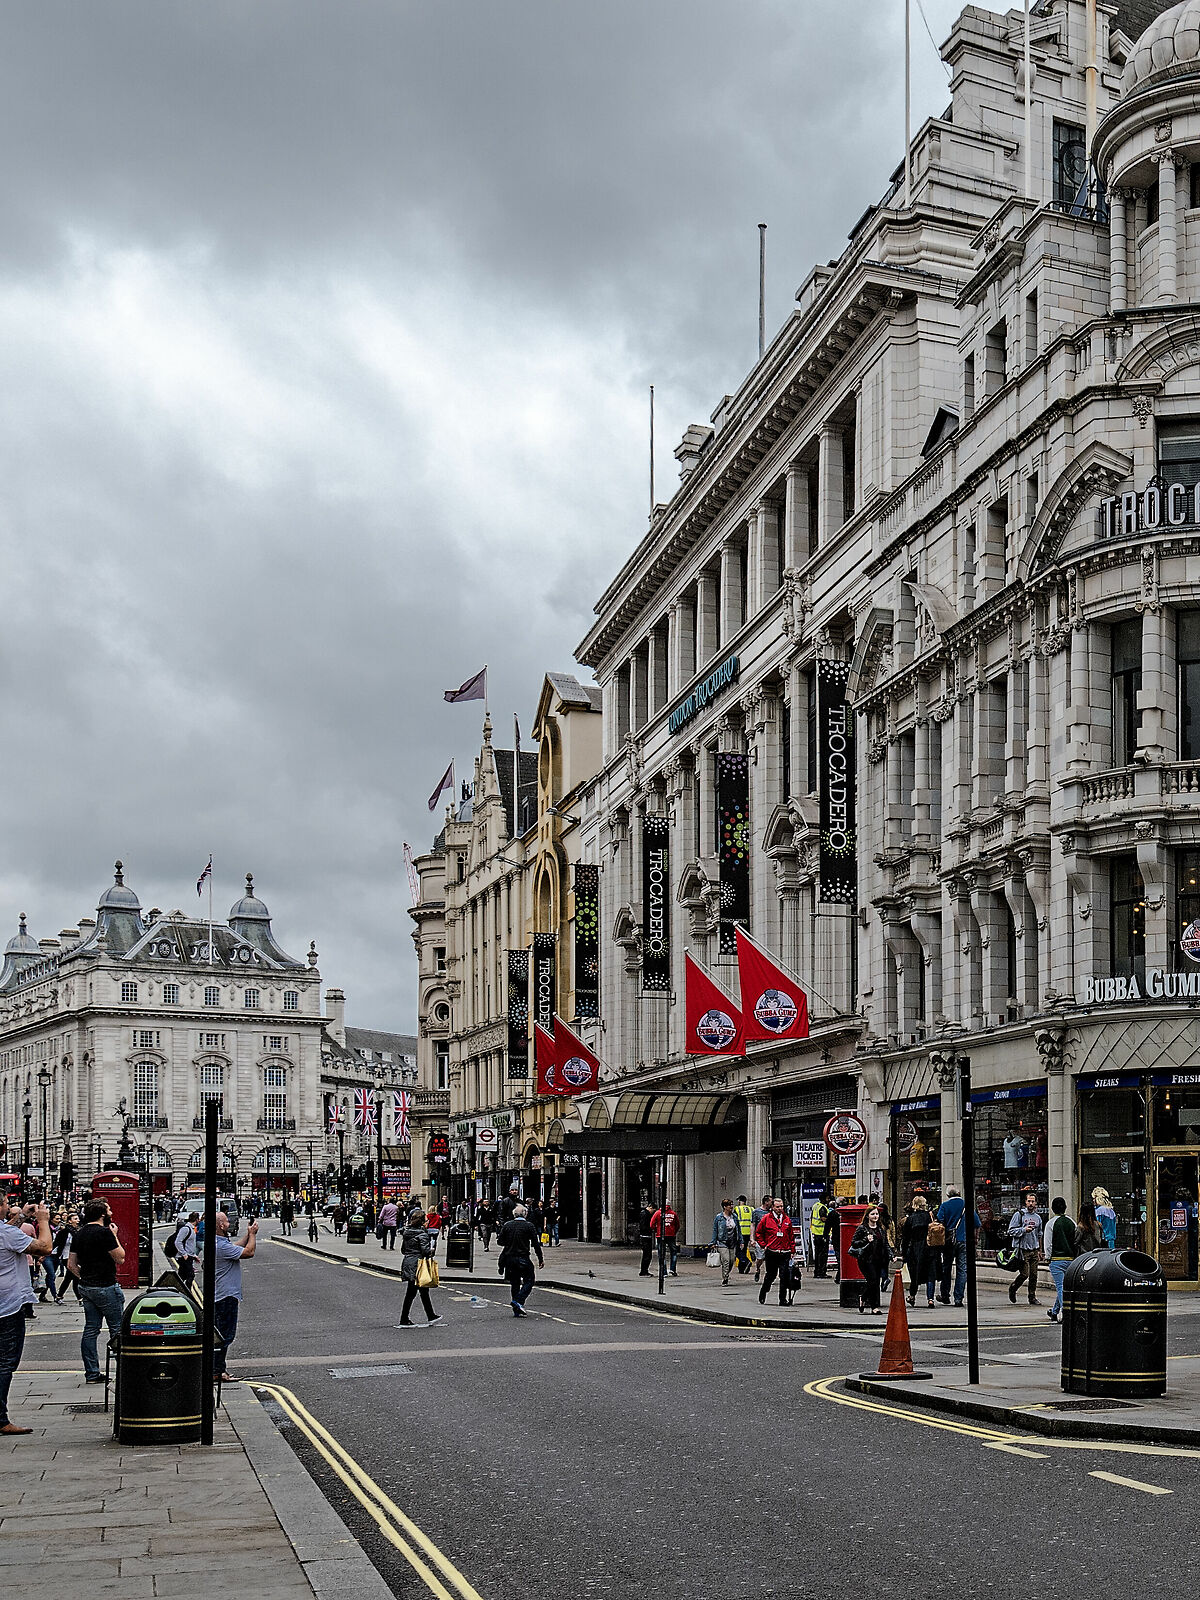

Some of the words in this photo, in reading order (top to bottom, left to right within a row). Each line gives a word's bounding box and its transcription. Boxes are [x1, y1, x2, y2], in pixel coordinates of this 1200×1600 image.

[695, 655, 738, 708] TROCADERO
[828, 705, 847, 850] TROCADERO
[650, 848, 663, 952] TROCADERO
[538, 957, 551, 1030] TROCADER
[1084, 975, 1141, 1004] BUBBA
[755, 1009, 777, 1019] BUBBA
[779, 1008, 797, 1018] GUMP
[1094, 1077, 1120, 1088] STEAKS
[1171, 1074, 1200, 1084] FRESH
[795, 1142, 824, 1151] THEATRE
[797, 1151, 823, 1160] TICKETS
